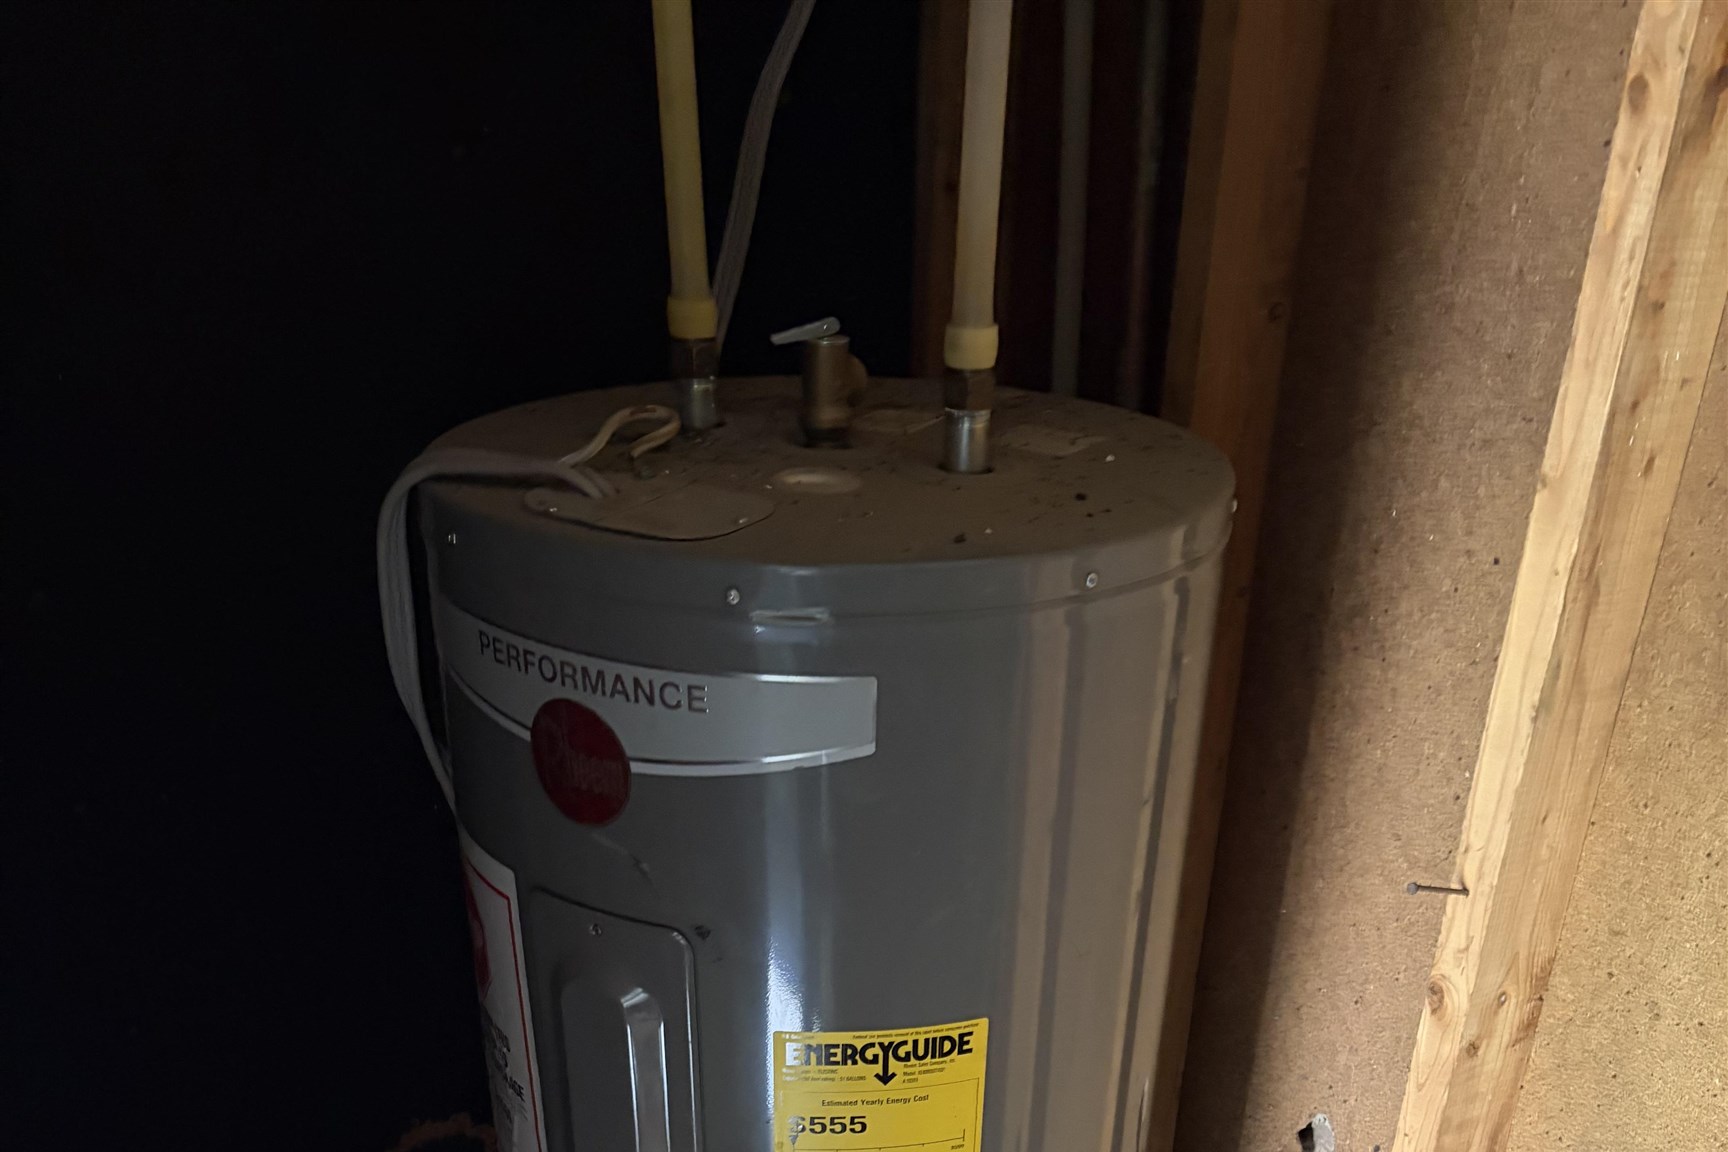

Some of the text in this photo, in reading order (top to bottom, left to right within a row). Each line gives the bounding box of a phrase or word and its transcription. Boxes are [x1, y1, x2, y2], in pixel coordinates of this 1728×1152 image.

[478, 629, 709, 713] PERFORMANCE
[785, 1031, 974, 1068] ENERGYGUIDE
[821, 1094, 929, 1108] Estimated Yearly Energy Cost
